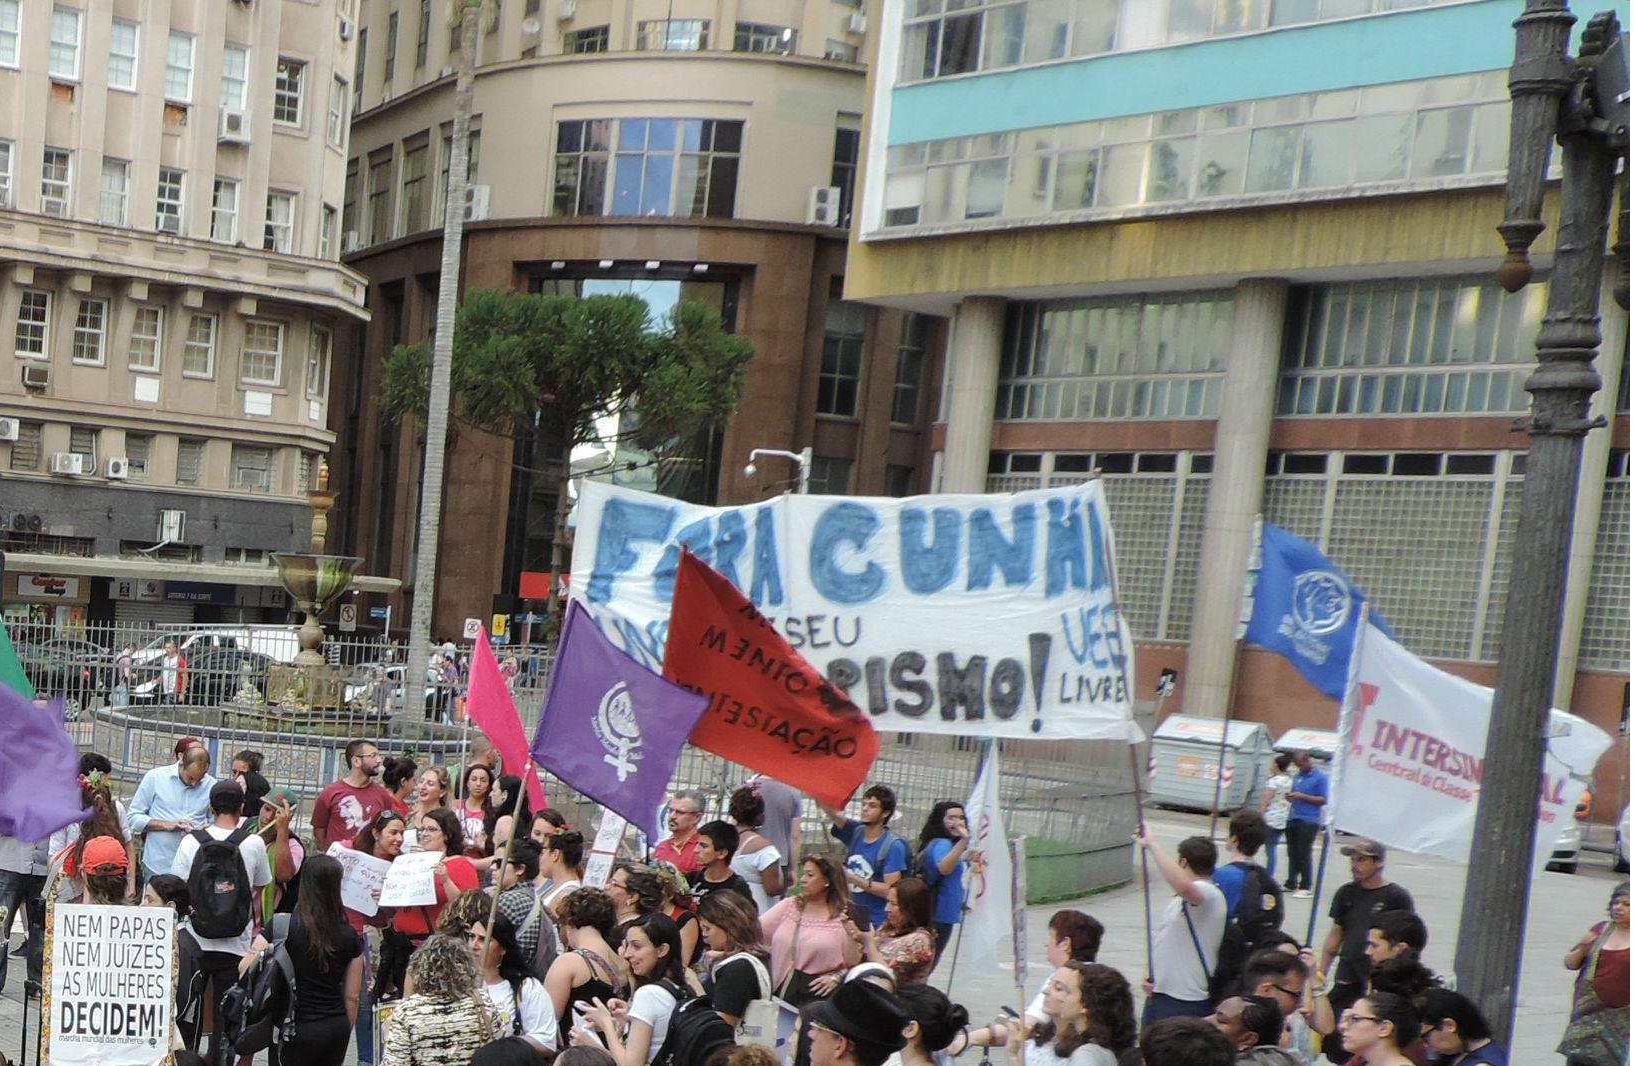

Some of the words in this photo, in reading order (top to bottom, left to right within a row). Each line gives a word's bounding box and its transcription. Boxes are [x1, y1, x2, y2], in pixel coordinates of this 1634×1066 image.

[786, 611, 861, 650] SEU
[825, 632, 1053, 734] PISMO!
[64, 914, 103, 938] NEM
[109, 916, 166, 940] PAPAS
[63, 941, 101, 968] NEM
[62, 971, 81, 997] AS
[86, 971, 165, 999] MULHERES
[60, 1001, 164, 1038] DECIDEM!
[59, 1034, 81, 1044] marcha
[82, 1035, 105, 1044] mundial
[105, 1036, 117, 1044] das
[117, 1036, 144, 1046] mulheres
